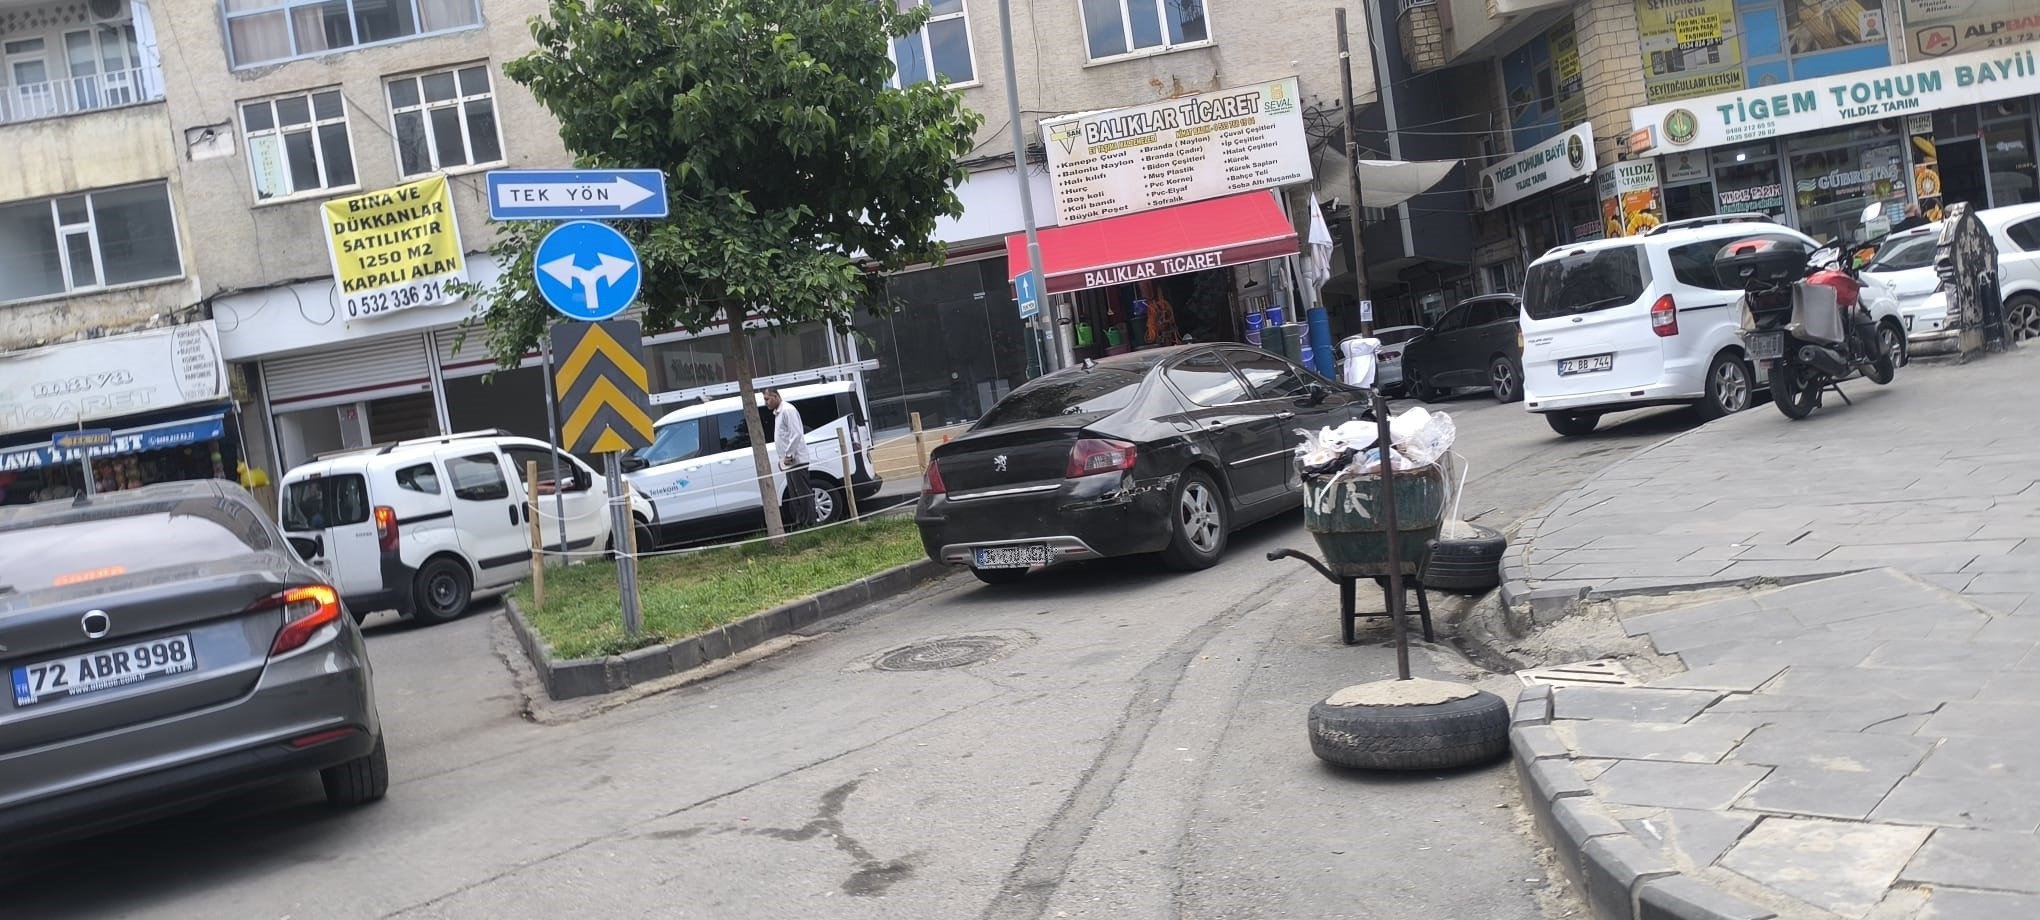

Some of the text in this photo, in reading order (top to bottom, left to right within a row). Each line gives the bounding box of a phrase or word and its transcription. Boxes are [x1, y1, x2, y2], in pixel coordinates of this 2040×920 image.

[1716, 89, 1817, 125] TİGEM
[1829, 70, 1942, 106] TOHUM
[1955, 50, 2036, 87] BAYİİ
[1264, 98, 1293, 111] SEVAL
[1839, 97, 1919, 120] YILDIZ TARIM
[1085, 92, 1260, 144] BALIKLAR TİCARET
[1223, 123, 1276, 138] Çuval Çeşitleri
[1234, 134, 1264, 145] Çeşitleri
[1144, 142, 1173, 153] Branda
[1226, 141, 1278, 155] Halat Çeşitleri
[1061, 151, 1127, 169] Kanepe Çuval
[1145, 152, 1174, 162] Branda
[1147, 155, 1206, 171] Bidon Çeşitleri
[1228, 155, 1249, 164] Kürek
[1518, 153, 1544, 174] TOHUM
[1062, 159, 1134, 177] Balonlu Naylon
[1167, 166, 1194, 176] Plastik
[1229, 159, 1278, 173] Kürek Sapları
[1619, 163, 1654, 177] YILDIZ
[1064, 173, 1107, 186] Halı kılıfı
[1230, 168, 1269, 181] Bahçe Teli
[1232, 182, 1250, 190] Soba
[1267, 172, 1301, 183] Muşamba
[1531, 171, 1547, 186] TARIM
[397, 186, 421, 202] VE
[510, 185, 609, 202] TEK YÖN
[1065, 186, 1088, 195] Hurç
[1067, 191, 1104, 204] Boş koli
[1151, 185, 1188, 197] Pvc-Elyaf
[1720, 184, 1781, 204] YILDIZ TARIM
[1068, 198, 1116, 213] Koli bandı
[1152, 196, 1184, 206] Sofralık
[333, 201, 443, 235] DÜKKANLAR
[1069, 204, 1129, 221] Büyük Poşet
[343, 221, 443, 253] SATILIKTIR
[358, 243, 433, 269] 1250 M2
[342, 257, 457, 293] KAPALI ALAN
[1085, 263, 1156, 287] BALIKLAR
[348, 298, 357, 317] 0
[361, 292, 389, 315] 532
[391, 286, 419, 308] 336
[422, 280, 441, 301] 31
[1563, 357, 1609, 371] 72 BB 744
[30, 640, 187, 692] 72 ABR 998
